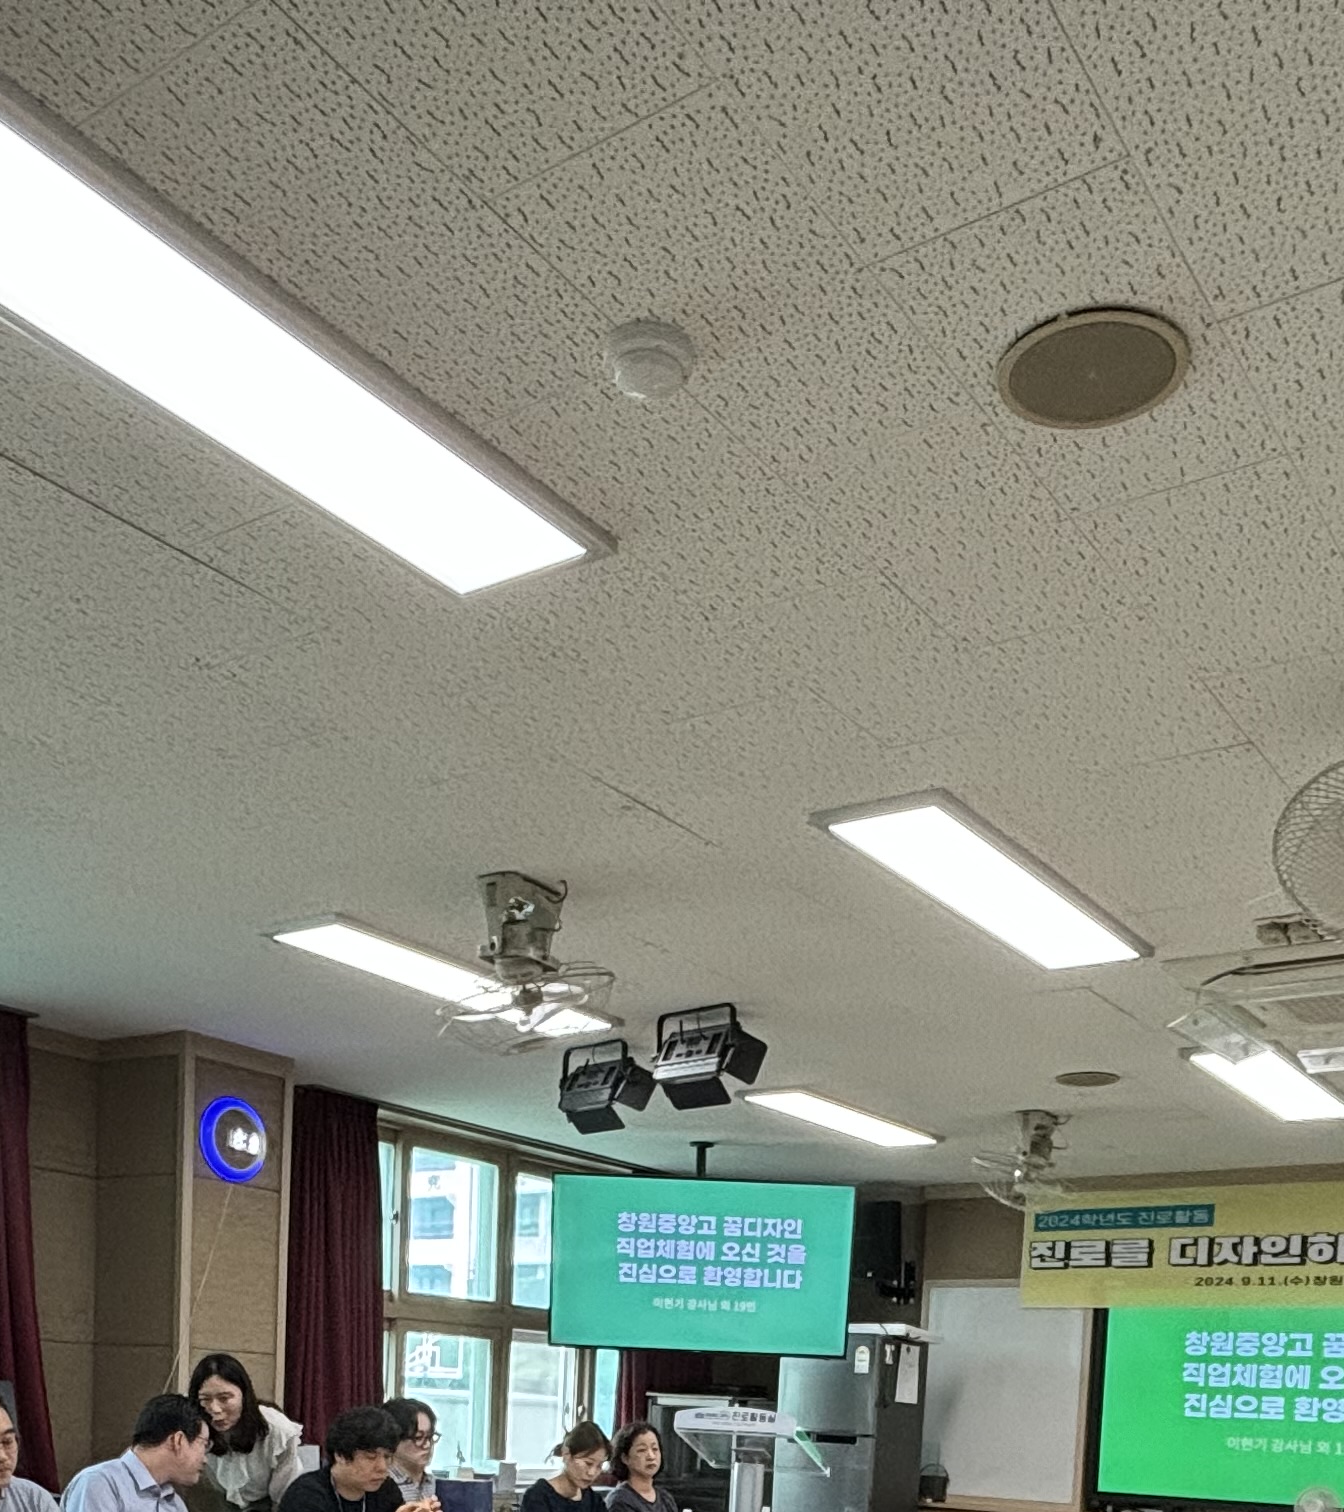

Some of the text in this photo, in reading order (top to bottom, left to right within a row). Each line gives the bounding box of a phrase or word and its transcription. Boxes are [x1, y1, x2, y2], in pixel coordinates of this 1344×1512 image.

[617, 1212, 802, 1239] 창원중앙고 꿈디자인
[1038, 1207, 1209, 1228] 2024학년도 진로활동
[616, 1237, 806, 1264] 직업체험에 오신 것을
[1030, 1238, 1153, 1269] 진로를
[618, 1262, 802, 1289] 진심으로 환영합니다
[1185, 1331, 1313, 1358] 창원중앙고
[1182, 1362, 1311, 1390] 직업체험에
[1183, 1393, 1285, 1421] 진심으로
[1271, 1438, 1312, 1455] 강사님
[1316, 1441, 1330, 1456] 외
